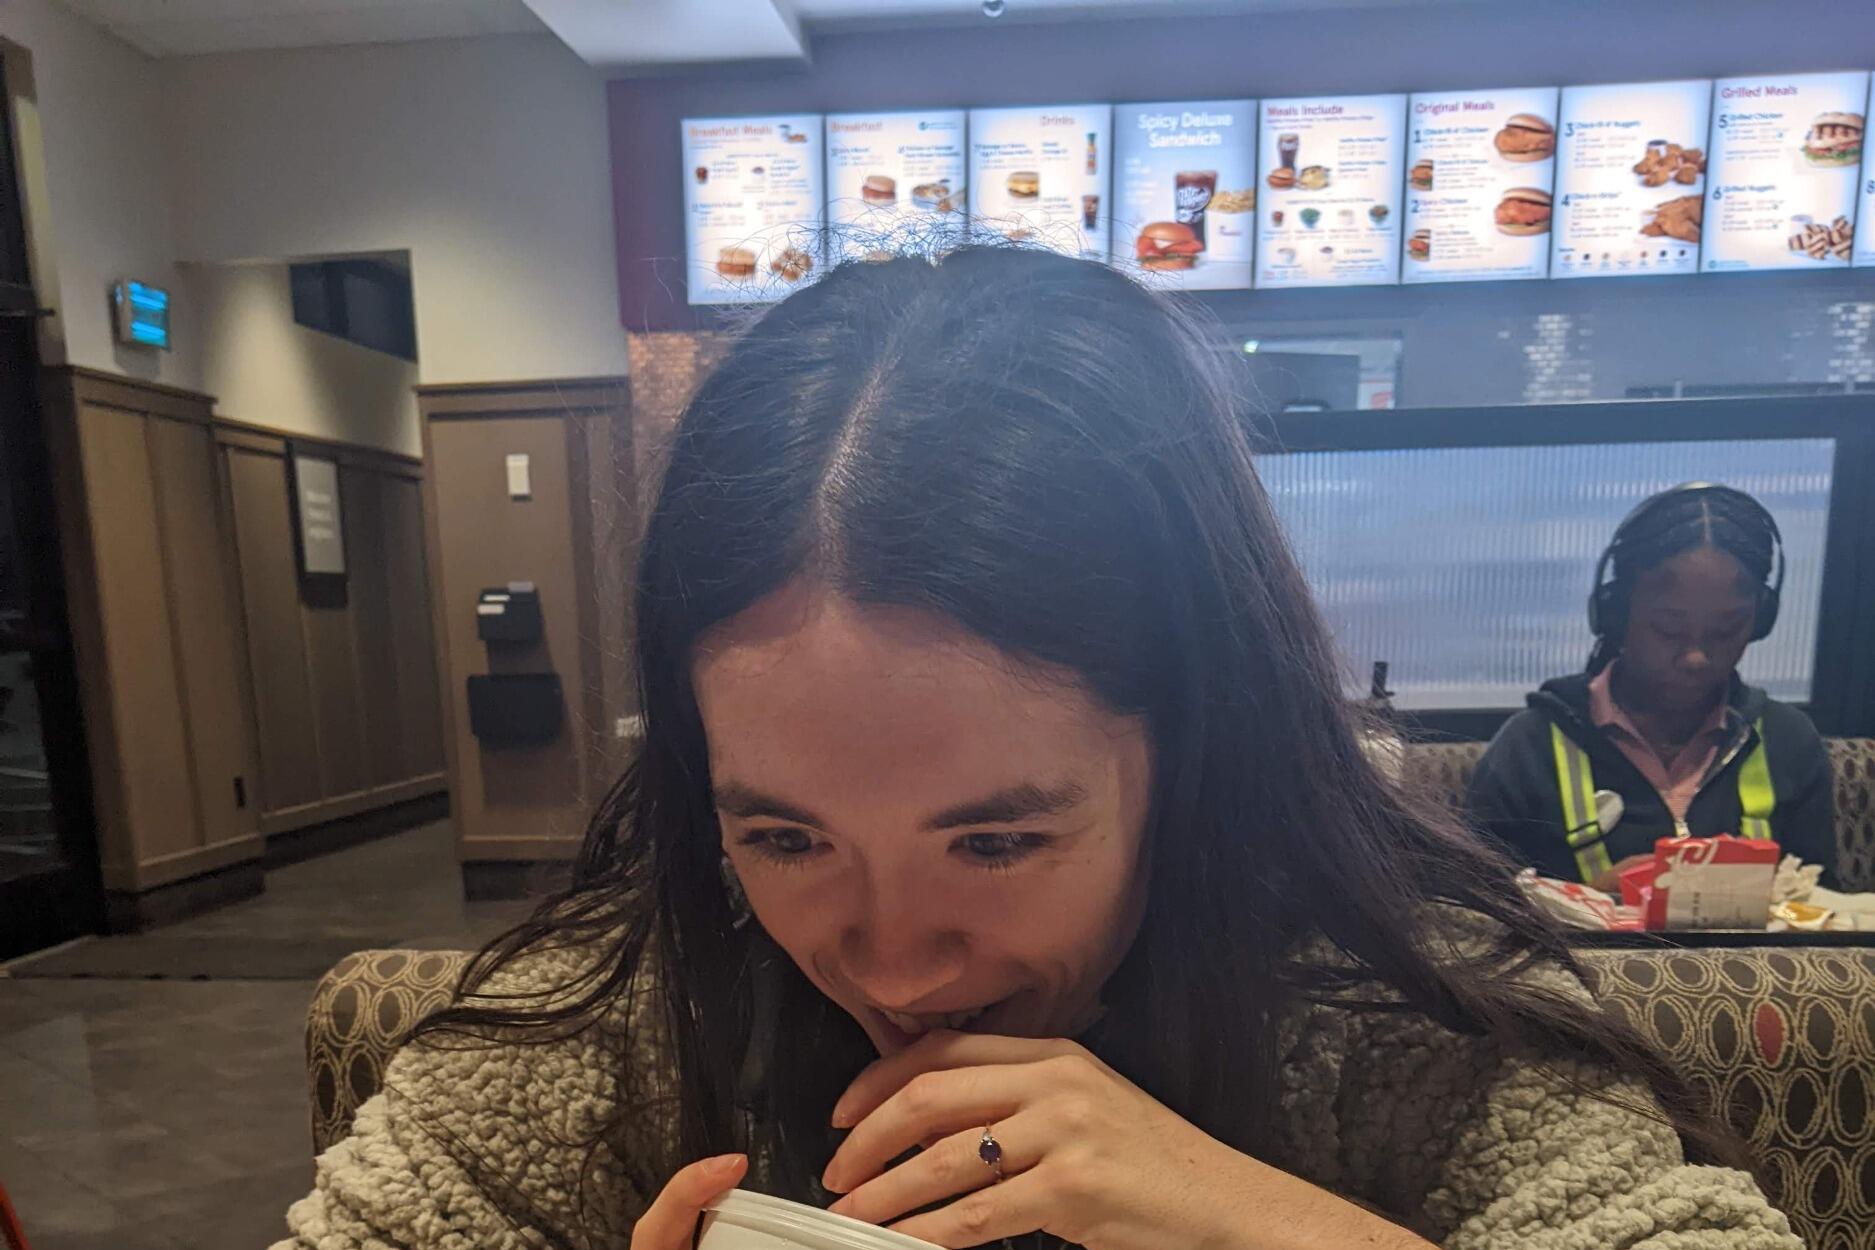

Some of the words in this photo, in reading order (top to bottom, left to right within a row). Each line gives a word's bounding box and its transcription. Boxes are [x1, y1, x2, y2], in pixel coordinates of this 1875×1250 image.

[1721, 87, 1761, 98] Grilled
[1765, 84, 1798, 95] Meals
[1138, 112, 1179, 131] Spicy
[1181, 111, 1233, 128] Deluxe
[1149, 130, 1222, 148] Sandwich
